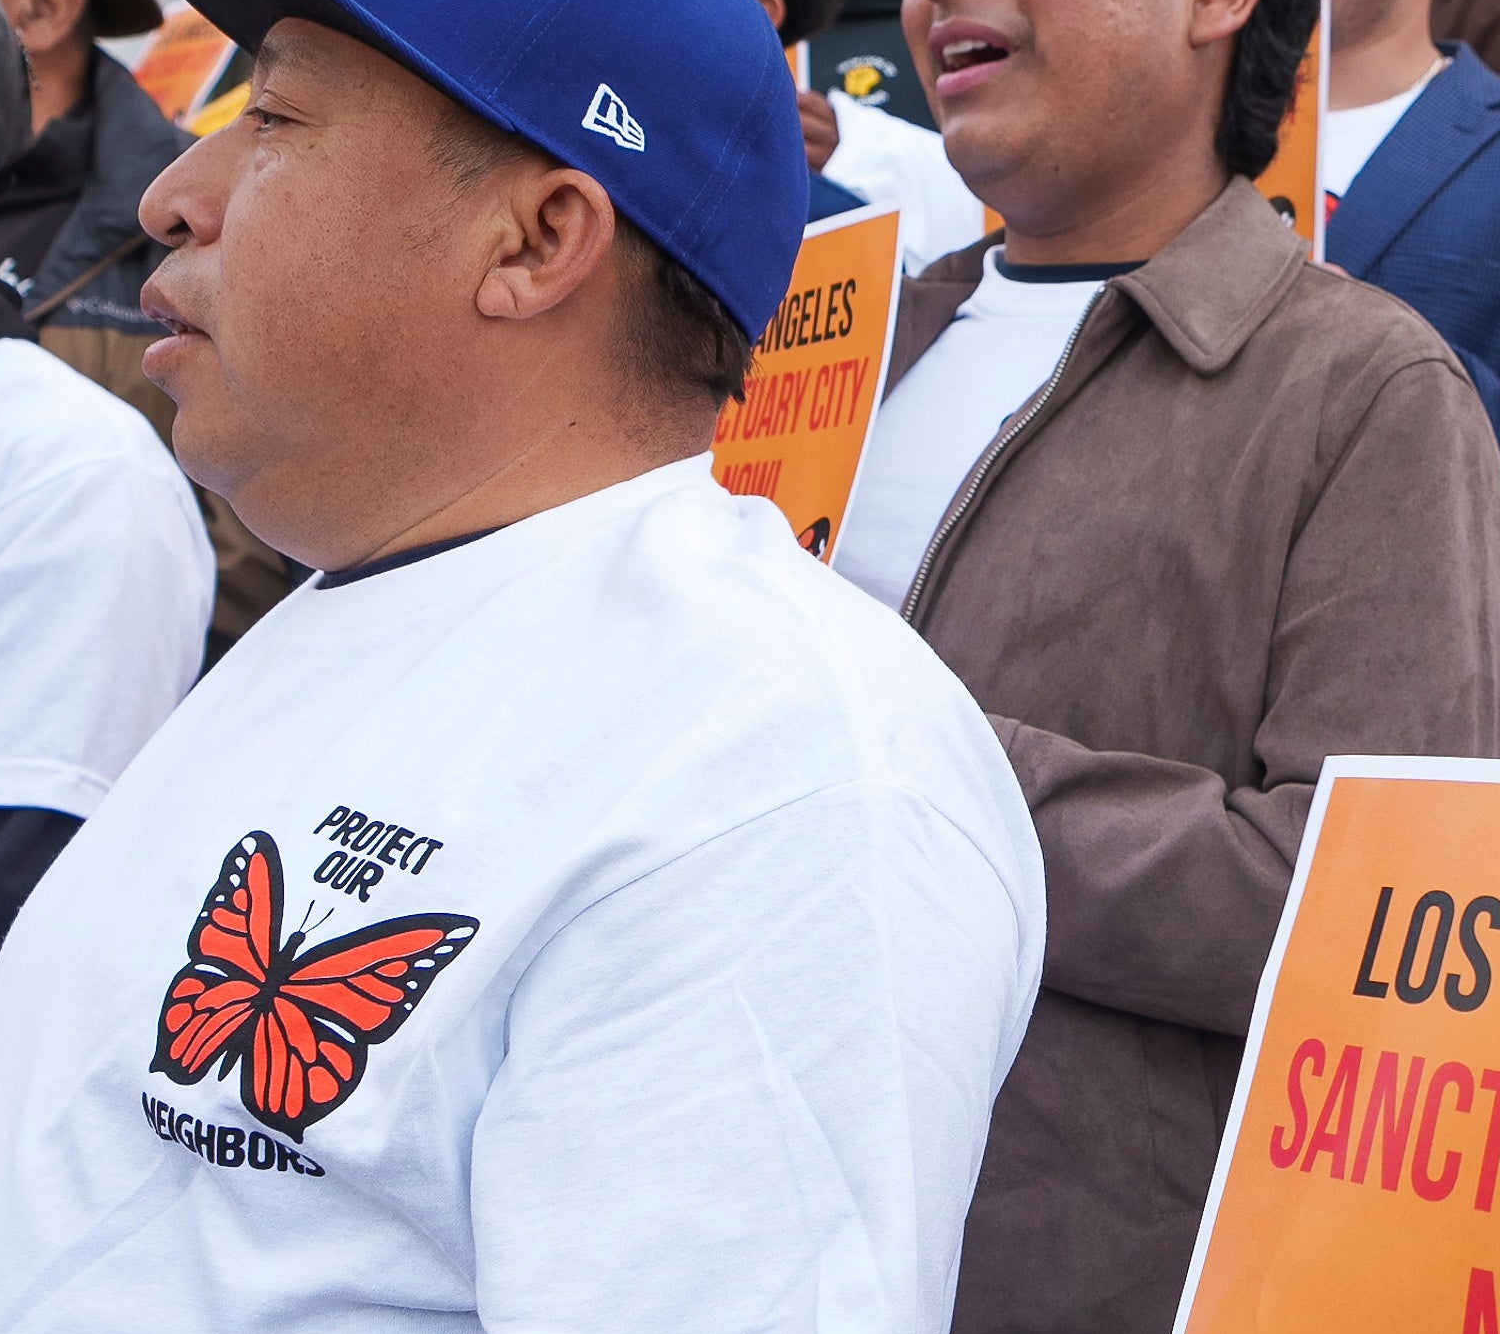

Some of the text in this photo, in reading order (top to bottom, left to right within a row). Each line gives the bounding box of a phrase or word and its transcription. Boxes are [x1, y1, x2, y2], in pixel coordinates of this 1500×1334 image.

[809, 356, 870, 433] CITY
[313, 805, 444, 876] PROTECT
[313, 850, 385, 903] OUR
[141, 1091, 327, 1178] NEIGHBORS
